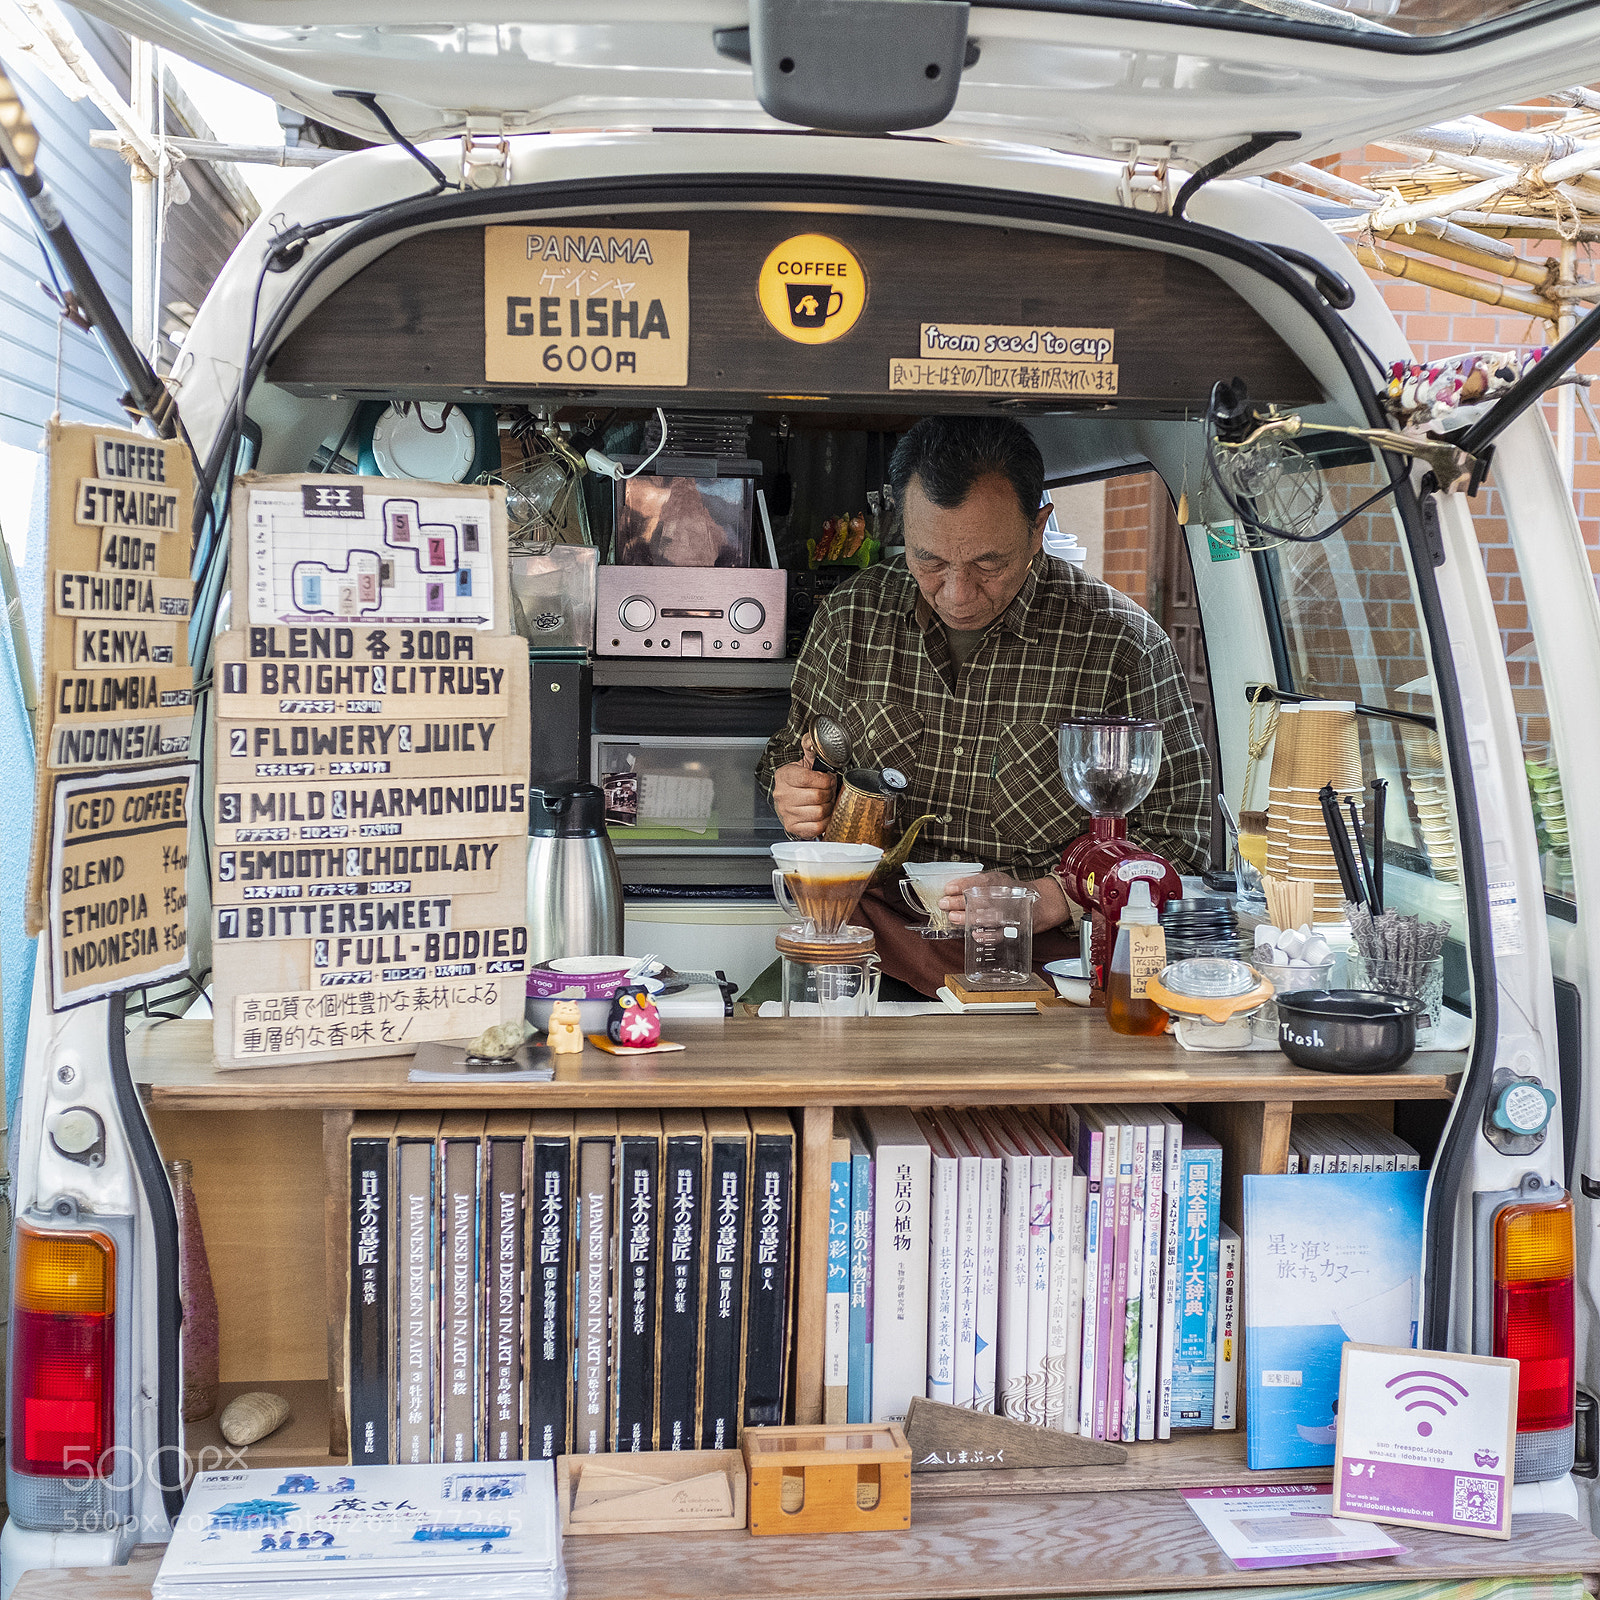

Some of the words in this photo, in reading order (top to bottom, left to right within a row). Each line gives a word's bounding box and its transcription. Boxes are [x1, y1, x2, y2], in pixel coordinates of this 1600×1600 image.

[526, 234, 653, 265] PANAMA
[539, 267, 636, 300] ゲイシャ
[777, 260, 847, 277] COFFEE
[507, 296, 670, 339] GEISHA
[543, 344, 636, 373] 600円
[925, 326, 978, 351] from
[985, 331, 1038, 353] seed
[1043, 331, 1067, 354] to
[1070, 336, 1112, 361] cup
[103, 441, 165, 483] COFFEE
[83, 486, 176, 528] STRAIGHT
[396, 515, 405, 529] 5
[103, 534, 156, 571] 400円
[431, 540, 440, 552] 7
[61, 574, 154, 613] ETHIOPIA
[308, 578, 314, 592] 1
[343, 588, 352, 601] 2
[362, 575, 371, 589] 3
[83, 629, 150, 663] KENYA
[250, 627, 353, 658] BLEND
[366, 630, 390, 660] 各
[400, 630, 473, 660] 300円
[59, 676, 158, 714] COLOMBIA
[280, 700, 335, 713] グアテマラ
[57, 724, 160, 764] INDONESIA
[232, 729, 246, 757] 2
[256, 763, 315, 776] エチオピア
[329, 761, 389, 775] コスタリカ
[67, 797, 115, 833] ICED
[122, 787, 183, 823] COFFEE
[221, 795, 239, 822] 3
[236, 828, 289, 842] グアテマラ
[300, 825, 348, 840] コロンビア
[62, 855, 124, 894] BLEND
[219, 852, 235, 881] 5
[243, 885, 302, 899] コスタリカ
[63, 893, 148, 938] ETHIOPIA
[220, 910, 238, 937] 7
[247, 900, 451, 938] BITTERSWEET
[64, 926, 158, 978] INDONESIA
[336, 927, 527, 967] FULL-BODIED
[1134, 942, 1159, 955] Syrup
[320, 971, 372, 986] グアテマラ
[382, 967, 426, 982] コロンビア
[487, 959, 524, 974] ペルー
[533, 980, 553, 988] 1000
[597, 981, 621, 989] 10000
[243, 983, 498, 1023] 高品質で個性豊かな素材による
[1281, 1023, 1324, 1047] Trash
[358, 1179, 381, 1265] 日本の意匠
[540, 1179, 563, 1264] 日本の意匠
[630, 1177, 651, 1262] 日本の意匠
[672, 1177, 694, 1261] 日本の意匠
[716, 1180, 739, 1263] 日本の意匠
[759, 1180, 782, 1263] 日本の意匠
[893, 1164, 912, 1251] 皇居の植物
[1104, 1187, 1115, 1228] 花の墨絵
[1120, 1186, 1130, 1226] 花の墨絵
[409, 1194, 424, 1263] JAPANESE
[454, 1193, 469, 1262] JAPANESE
[500, 1191, 515, 1260] JAPANESE
[589, 1193, 604, 1261] JAPANESE
[829, 1180, 848, 1278] かさね彩め
[1184, 1164, 1209, 1316] 国鉄全駅ルーツ大辞典
[851, 1210, 868, 1308] 和装の小物百科
[1267, 1233, 1330, 1262] 星と海と
[1034, 1245, 1046, 1291] 松・竹・梅
[1277, 1258, 1364, 1283] 旅するカヌー
[409, 1266, 424, 1316] DESIGN
[454, 1265, 468, 1316] DESIGN
[499, 1263, 514, 1314] DESIGN
[588, 1263, 603, 1314] DESIGN
[409, 1321, 423, 1337] IN
[453, 1320, 468, 1335] IN
[499, 1318, 513, 1334] IN
[588, 1318, 601, 1334] IN
[409, 1339, 423, 1368] ART
[453, 1338, 468, 1367] ART
[498, 1335, 512, 1366] ART
[587, 1335, 601, 1366] ART
[452, 1382, 467, 1395] 桜
[946, 1450, 1004, 1464] しまぶっく
[1394, 1443, 1453, 1456] freespot_idobata
[328, 1498, 418, 1512] 茂さん
[1346, 1501, 1434, 1517] www.idobata-kotsubo.net
